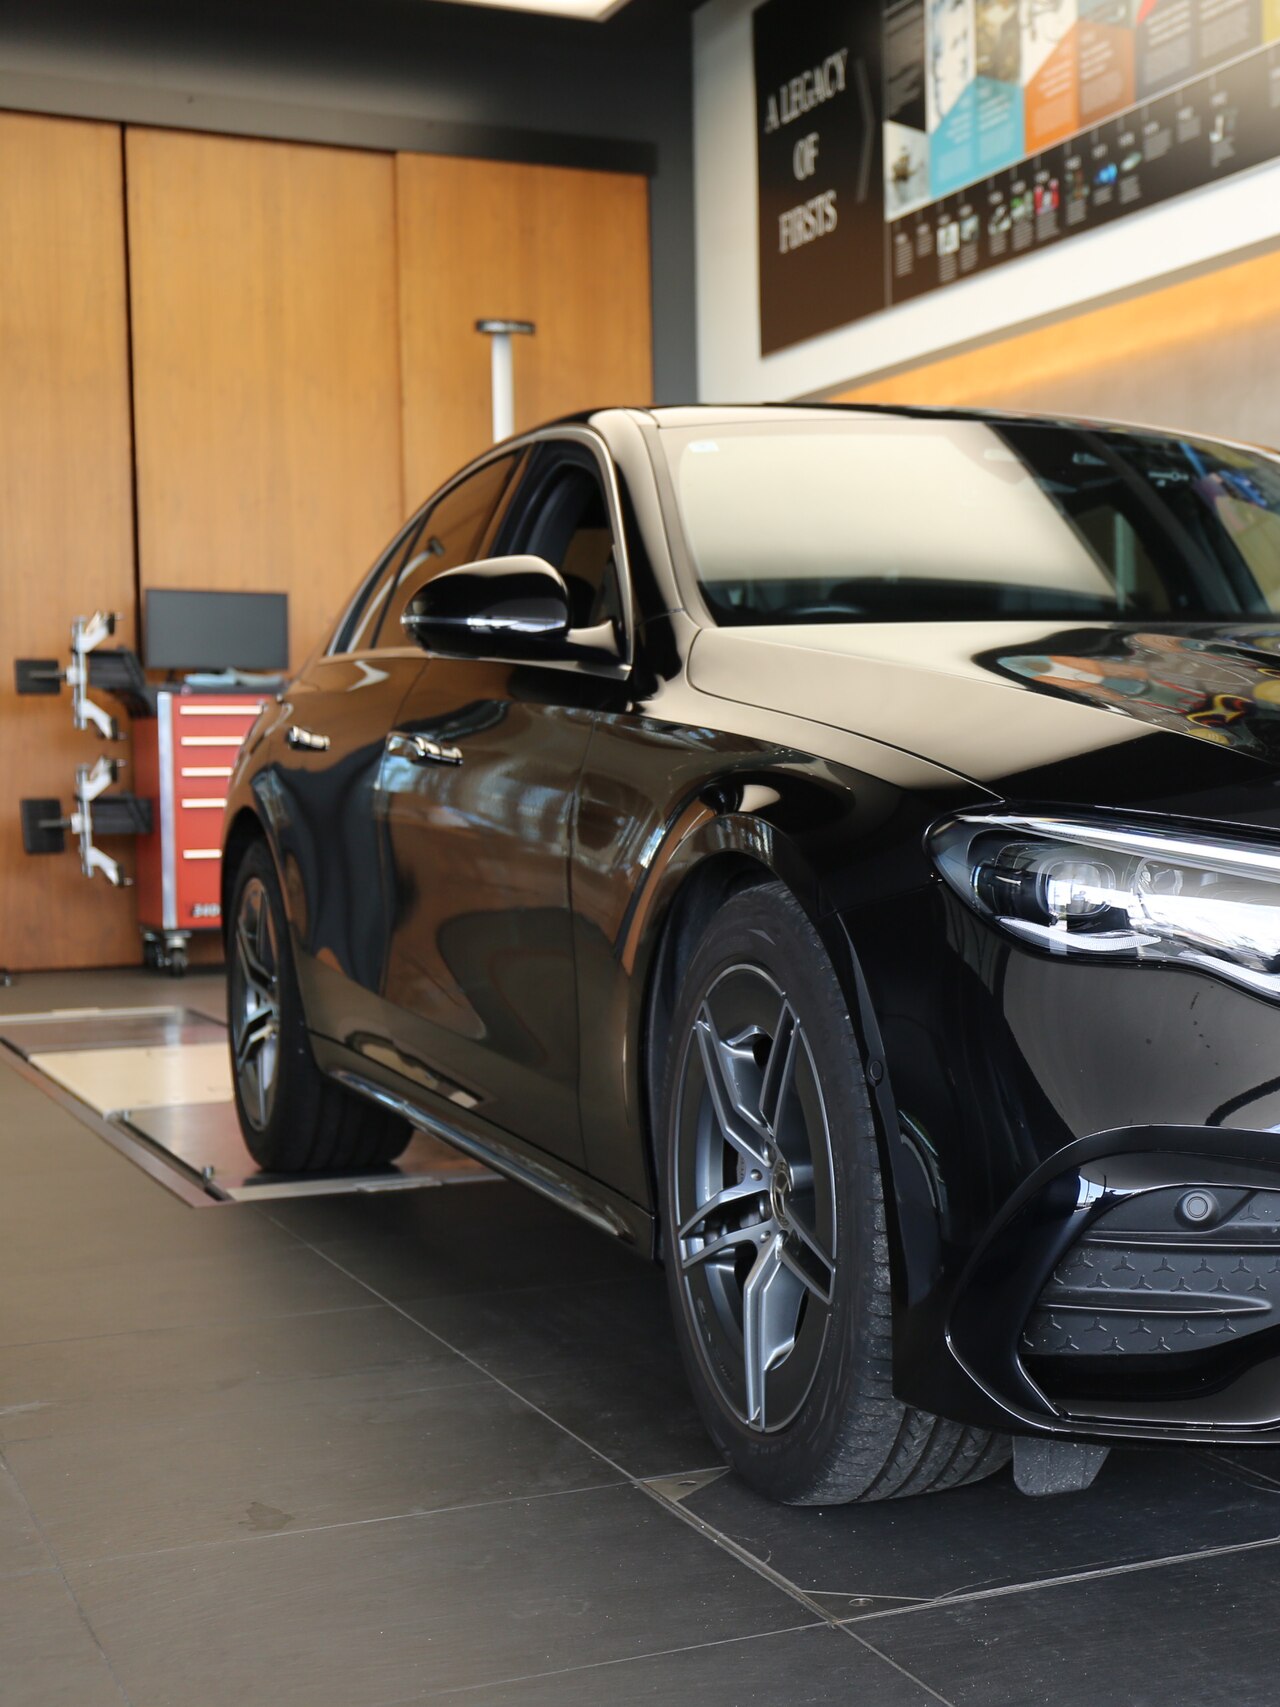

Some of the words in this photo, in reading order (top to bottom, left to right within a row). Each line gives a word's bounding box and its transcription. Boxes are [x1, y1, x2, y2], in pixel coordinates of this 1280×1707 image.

[765, 93, 780, 134] A
[780, 48, 848, 125] LEGACY
[793, 131, 819, 181] OF
[778, 189, 838, 254] FIRSTS
